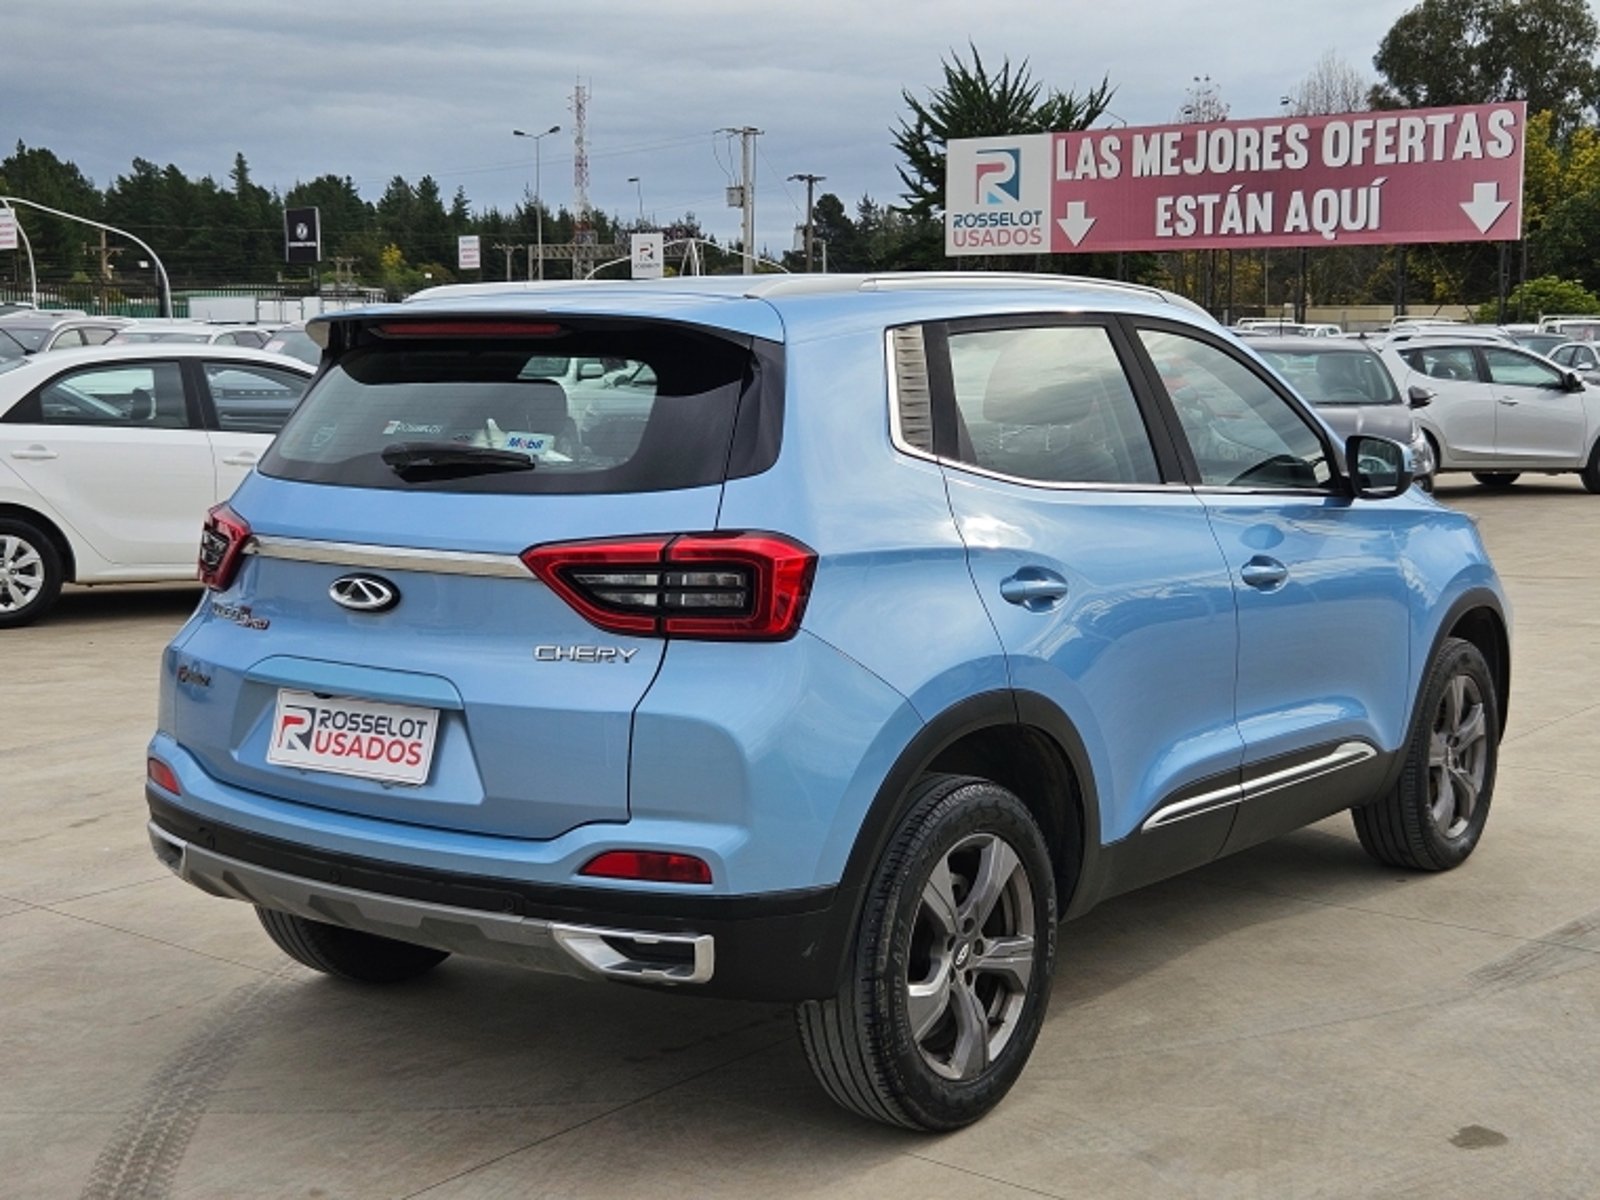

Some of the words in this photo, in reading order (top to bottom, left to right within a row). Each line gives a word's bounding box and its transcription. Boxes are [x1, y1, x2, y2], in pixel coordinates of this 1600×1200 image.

[1056, 135, 1122, 181] LAS
[1132, 123, 1310, 178] MEJORES
[1322, 108, 1516, 168] OFERTAS
[953, 210, 1042, 228] ROSSELOT
[1156, 184, 1274, 237] ESTÁN
[1283, 177, 1389, 240] AQUÍ
[953, 227, 1042, 247] USADOS
[534, 645, 640, 663] CHERY
[318, 709, 428, 740] ROSSELOT
[314, 730, 423, 766] USADOS
